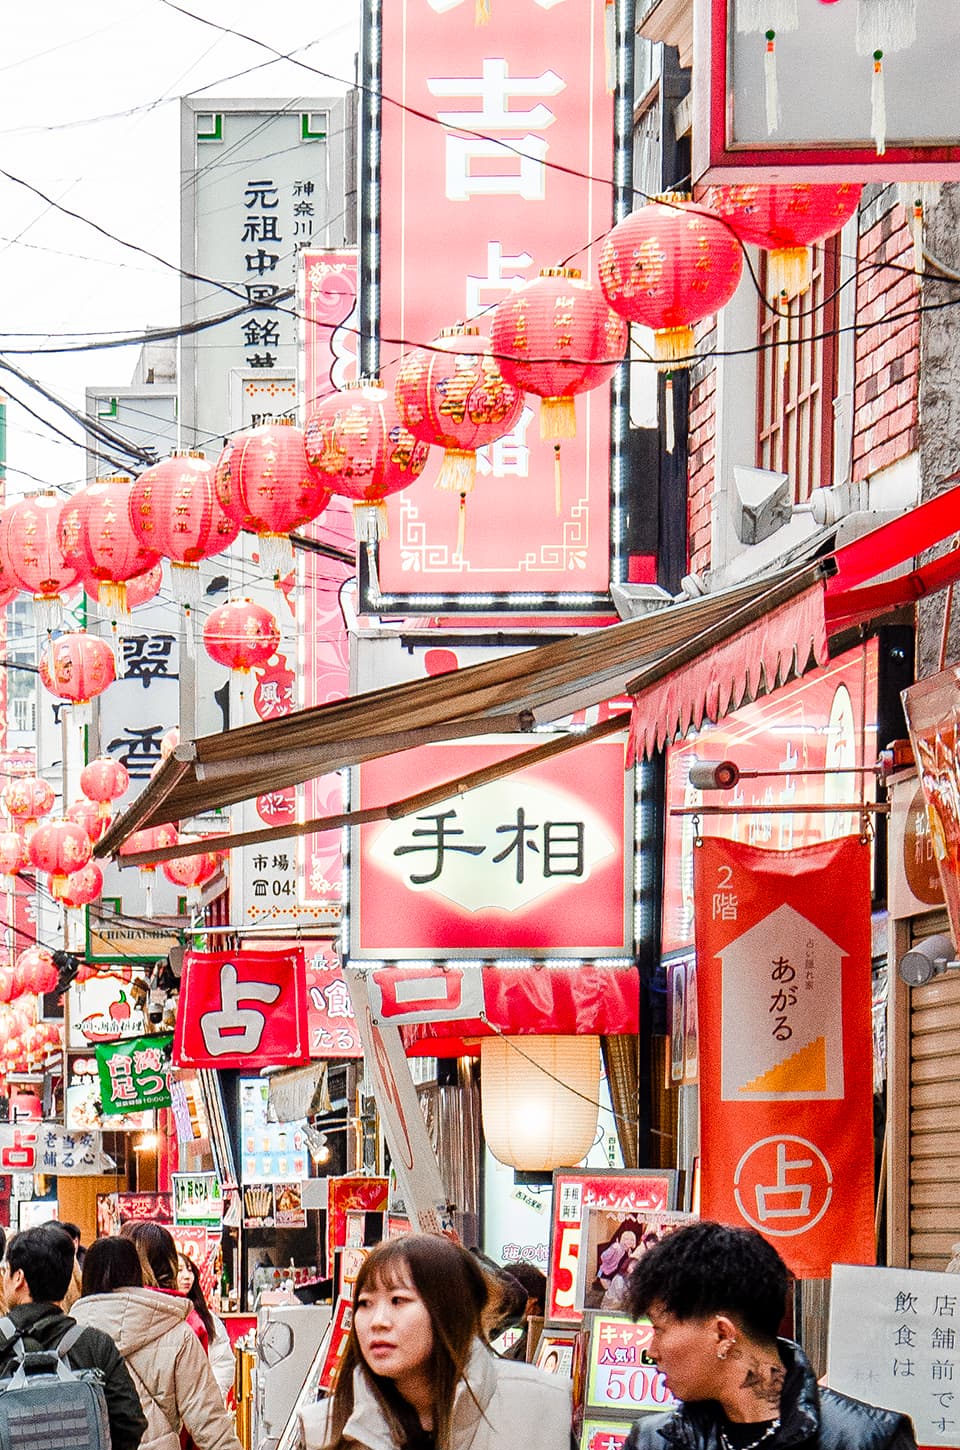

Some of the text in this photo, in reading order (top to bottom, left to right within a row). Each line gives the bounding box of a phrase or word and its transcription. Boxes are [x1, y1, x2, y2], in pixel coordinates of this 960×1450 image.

[252, 854, 296, 872] 市場
[394, 807, 585, 884] 手相
[712, 865, 738, 921] 2階
[200, 962, 281, 1056] 占
[769, 956, 798, 1041] あがる
[106, 1047, 161, 1077] 台湾
[2, 1130, 37, 1169] 占
[754, 1143, 813, 1222] 占
[893, 1290, 918, 1377] 飲食は
[931, 1294, 957, 1433] 店舗前です
